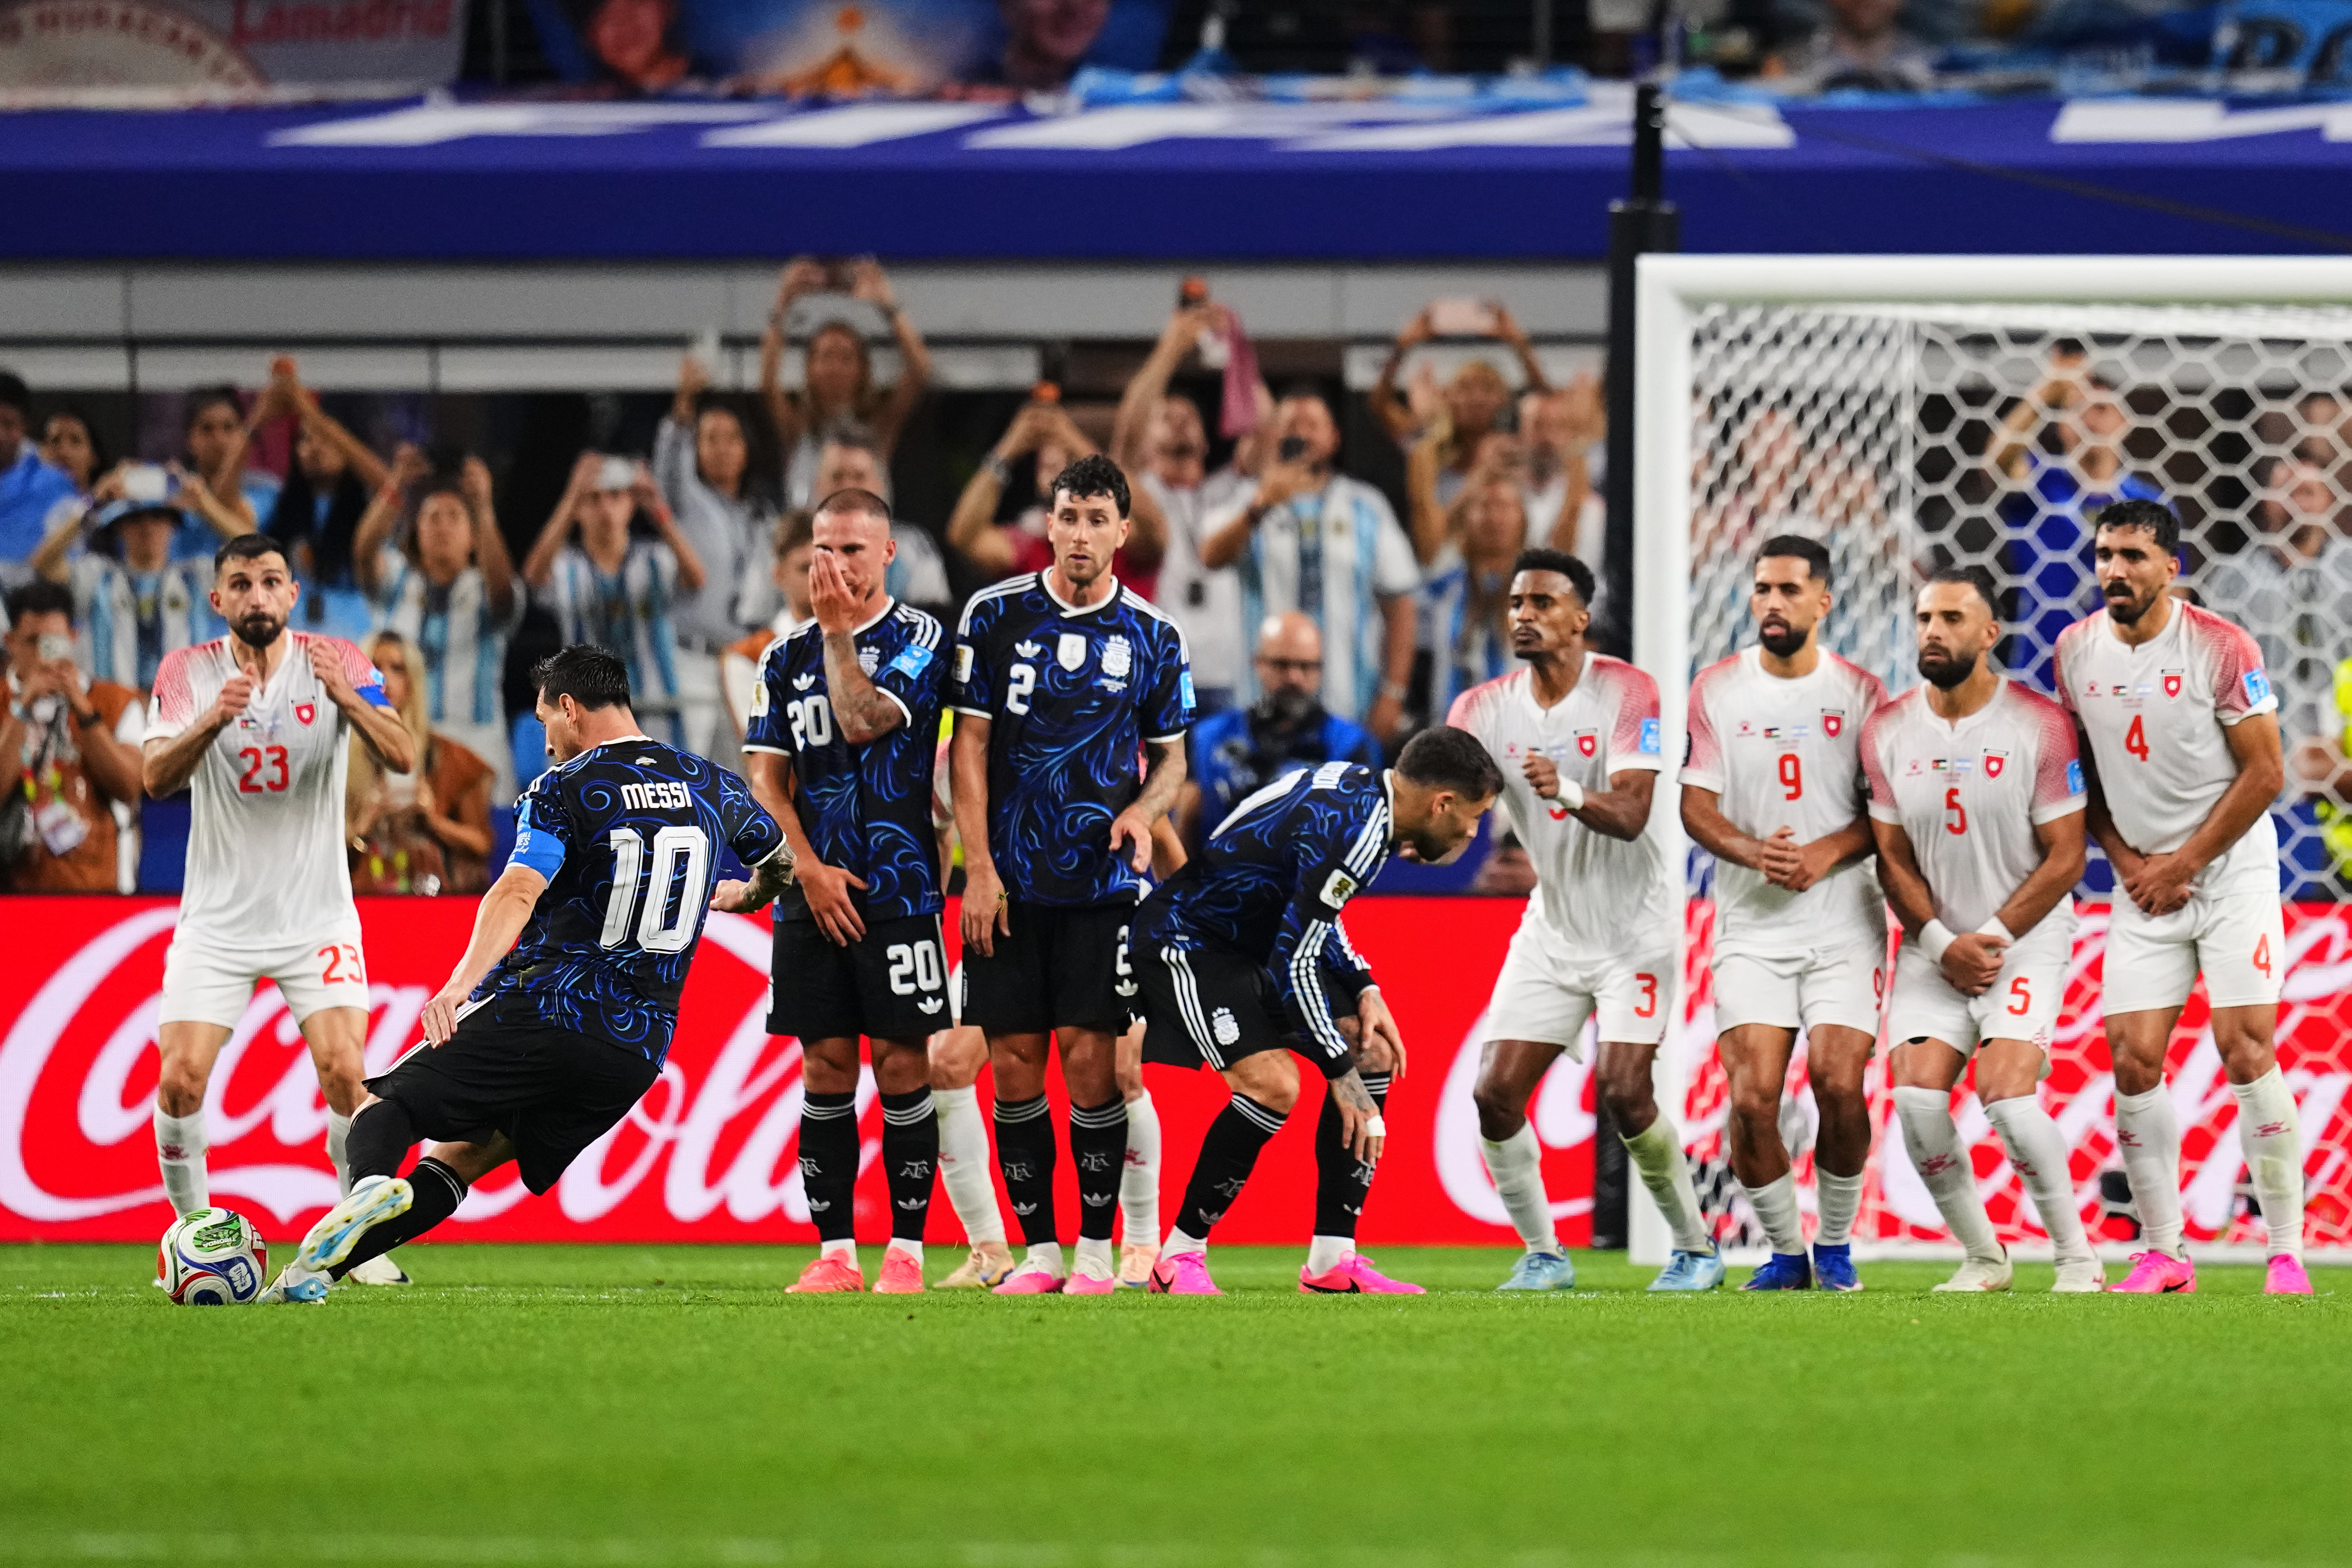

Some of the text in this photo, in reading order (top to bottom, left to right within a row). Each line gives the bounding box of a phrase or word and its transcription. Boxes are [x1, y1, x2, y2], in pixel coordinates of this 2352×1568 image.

[1006, 663, 1037, 716] 2
[787, 695, 833, 753] 20
[2125, 714, 2150, 762] 4
[239, 745, 290, 792] 23
[1778, 753, 1802, 801] 9
[620, 781, 693, 810] MESSI
[1945, 788, 1967, 835] 5
[600, 826, 710, 955] 10
[318, 943, 363, 985] 23
[887, 939, 943, 995] 20
[2253, 933, 2272, 978] 4
[1634, 973, 1658, 1018] 3
[2007, 976, 2031, 1016] 5
[203, 1237, 236, 1248] TRIONDA
